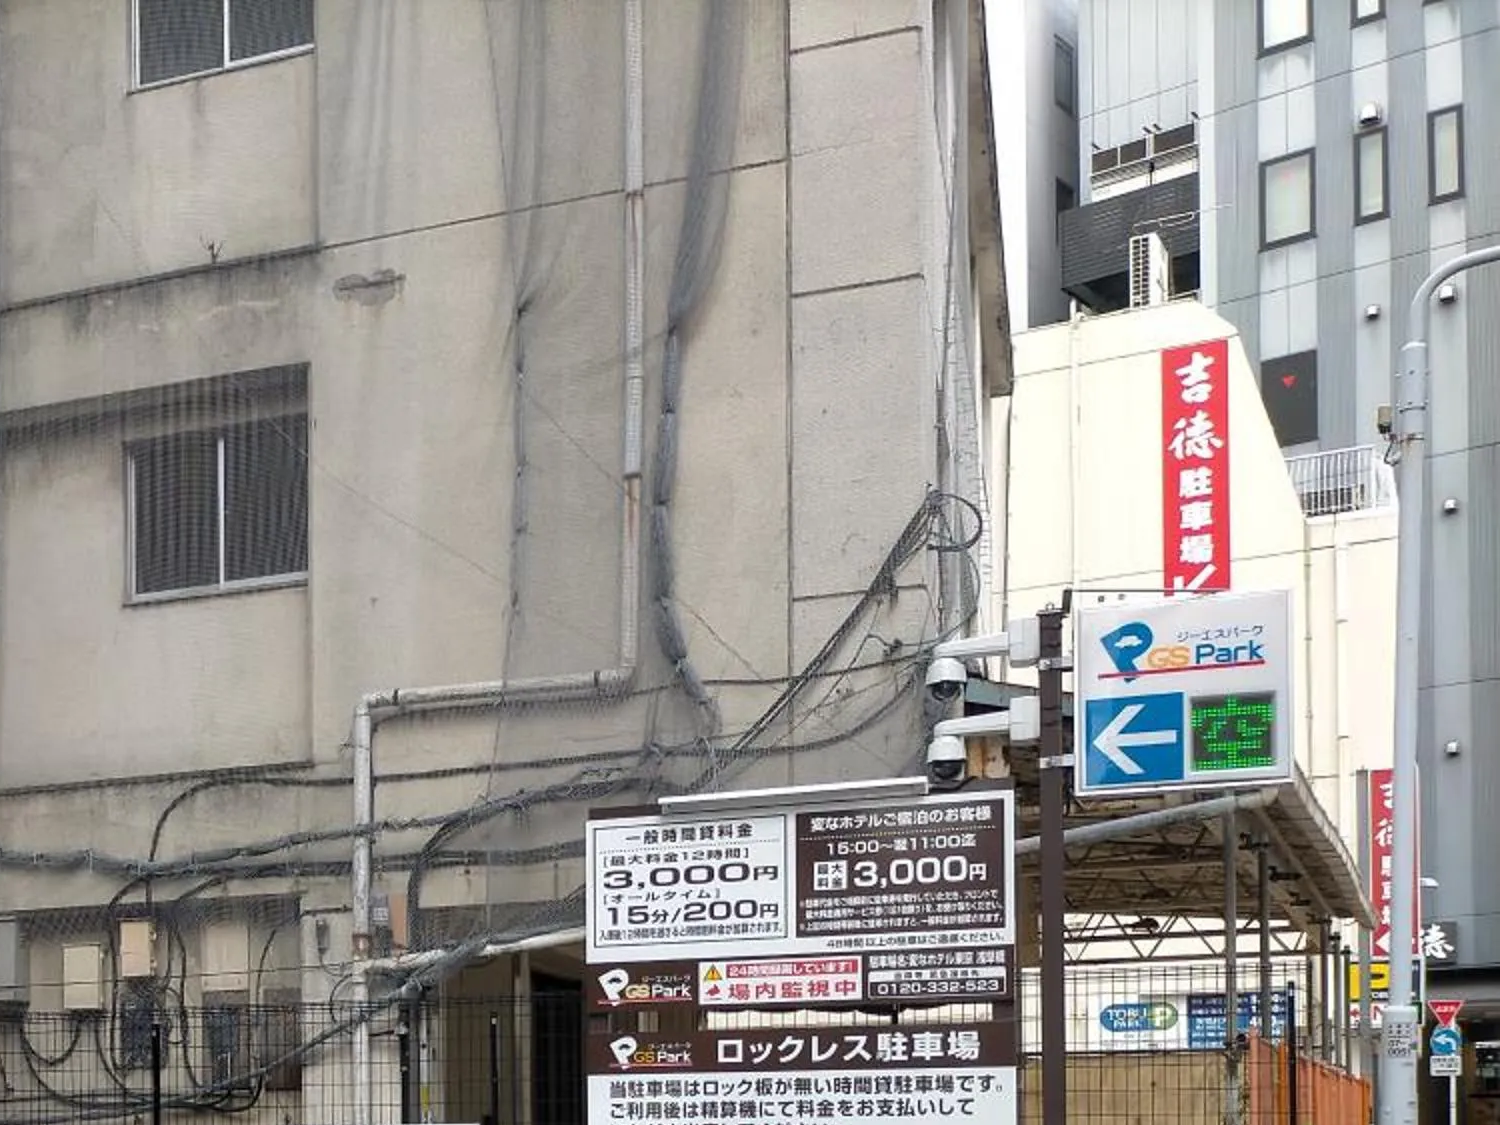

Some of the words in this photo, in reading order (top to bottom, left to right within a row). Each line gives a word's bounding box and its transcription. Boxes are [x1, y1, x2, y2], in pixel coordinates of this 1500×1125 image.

[1168, 351, 1225, 564] 吉徳駐車場
[1176, 624, 1264, 643] ジーエスパーク
[1147, 645, 1190, 668] GS
[1195, 640, 1265, 664] Park
[1190, 696, 1276, 771] 空
[810, 805, 991, 832] 変なホテルご宿泊のお客様
[625, 823, 753, 844] 一般時間貸料金
[603, 863, 778, 890] 3,000円
[853, 856, 987, 888] 3,000円
[607, 900, 779, 925] 15分/200円
[625, 984, 650, 999] GS
[652, 983, 691, 997] Park
[728, 980, 857, 1000] 場内監視中
[633, 1051, 655, 1063] GS
[657, 1050, 692, 1063] Park
[717, 1031, 980, 1064] ロックレス駐車場
[609, 1075, 1003, 1098] 当駐車場はロック板が無い時間貸駐車場です。
[610, 1098, 975, 1120] ご利用後は精算機にて料金をお支払いして
